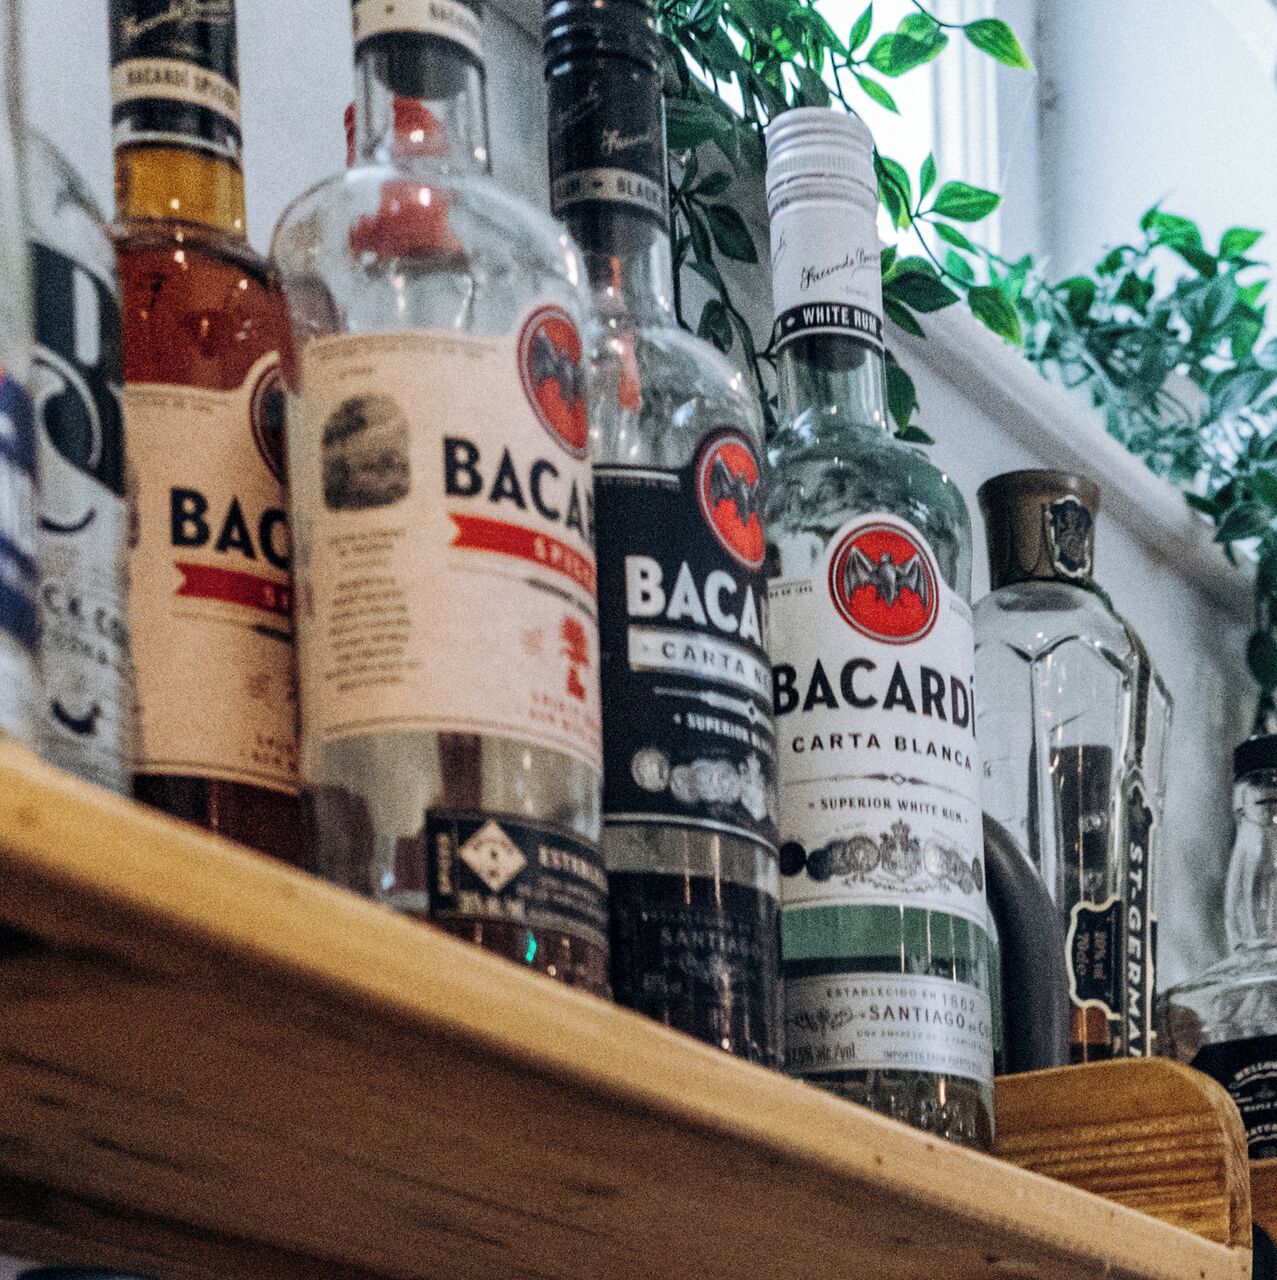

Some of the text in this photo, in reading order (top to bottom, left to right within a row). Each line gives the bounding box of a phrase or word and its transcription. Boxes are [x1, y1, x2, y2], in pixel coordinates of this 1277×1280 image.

[801, 304, 850, 328] WHITE
[660, 640, 745, 676] CARTA
[791, 733, 881, 754] CARTA
[893, 735, 972, 772] BLANCA
[819, 797, 892, 811] SUPERIOR
[897, 799, 938, 817] WHITE
[868, 1004, 966, 1030] SANTIAGO
